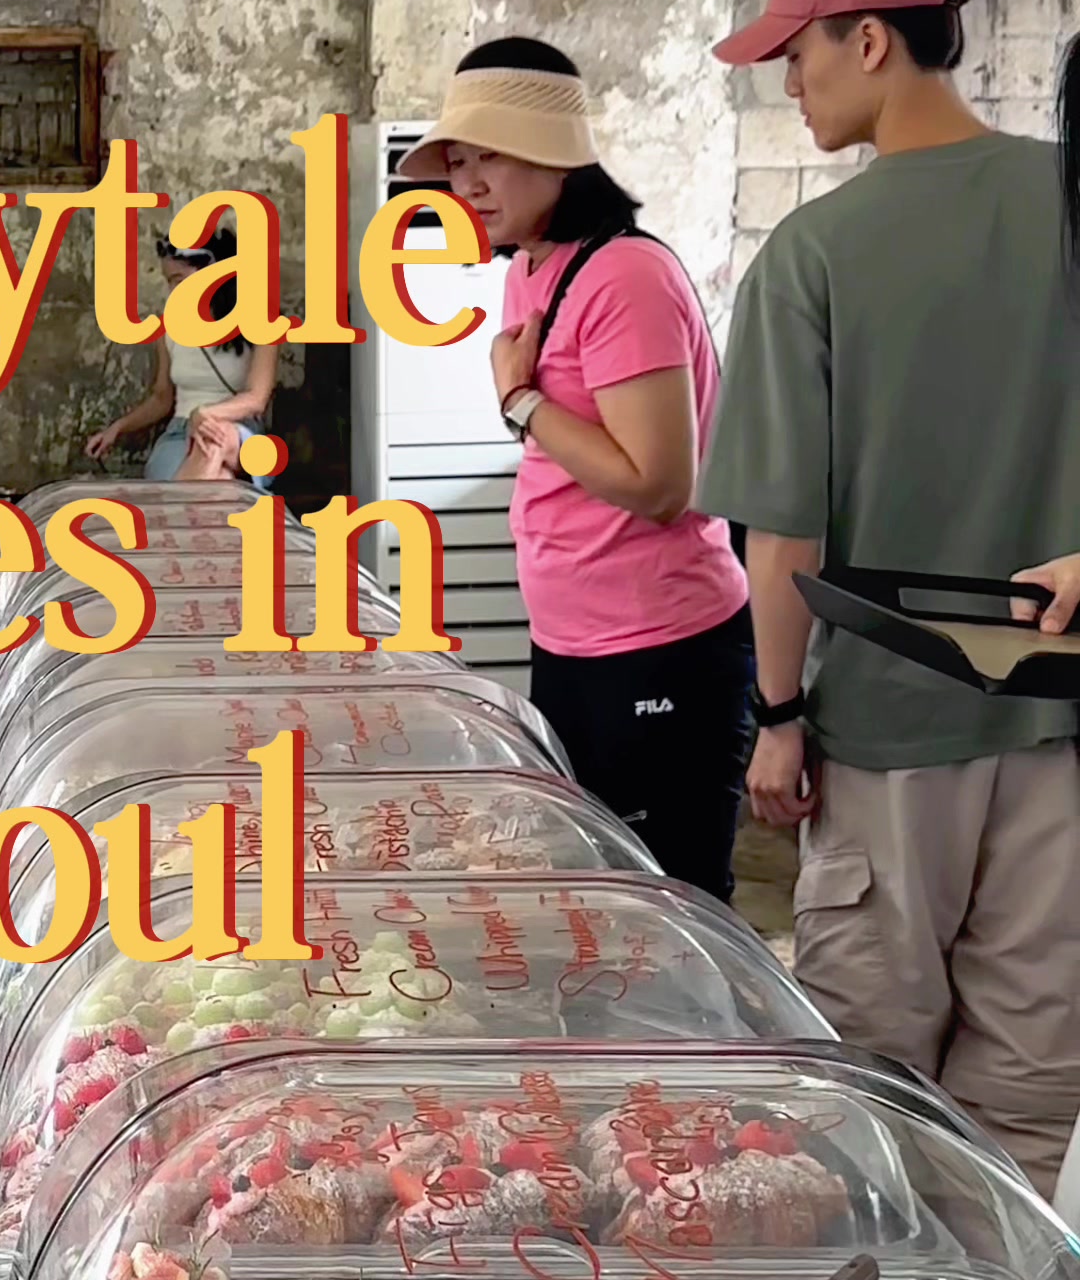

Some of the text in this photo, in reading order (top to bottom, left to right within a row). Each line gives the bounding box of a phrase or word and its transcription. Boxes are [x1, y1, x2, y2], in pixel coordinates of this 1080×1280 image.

[634, 698, 675, 716] FILA
[303, 929, 373, 999] Fresh
[388, 929, 453, 1002] Cream
